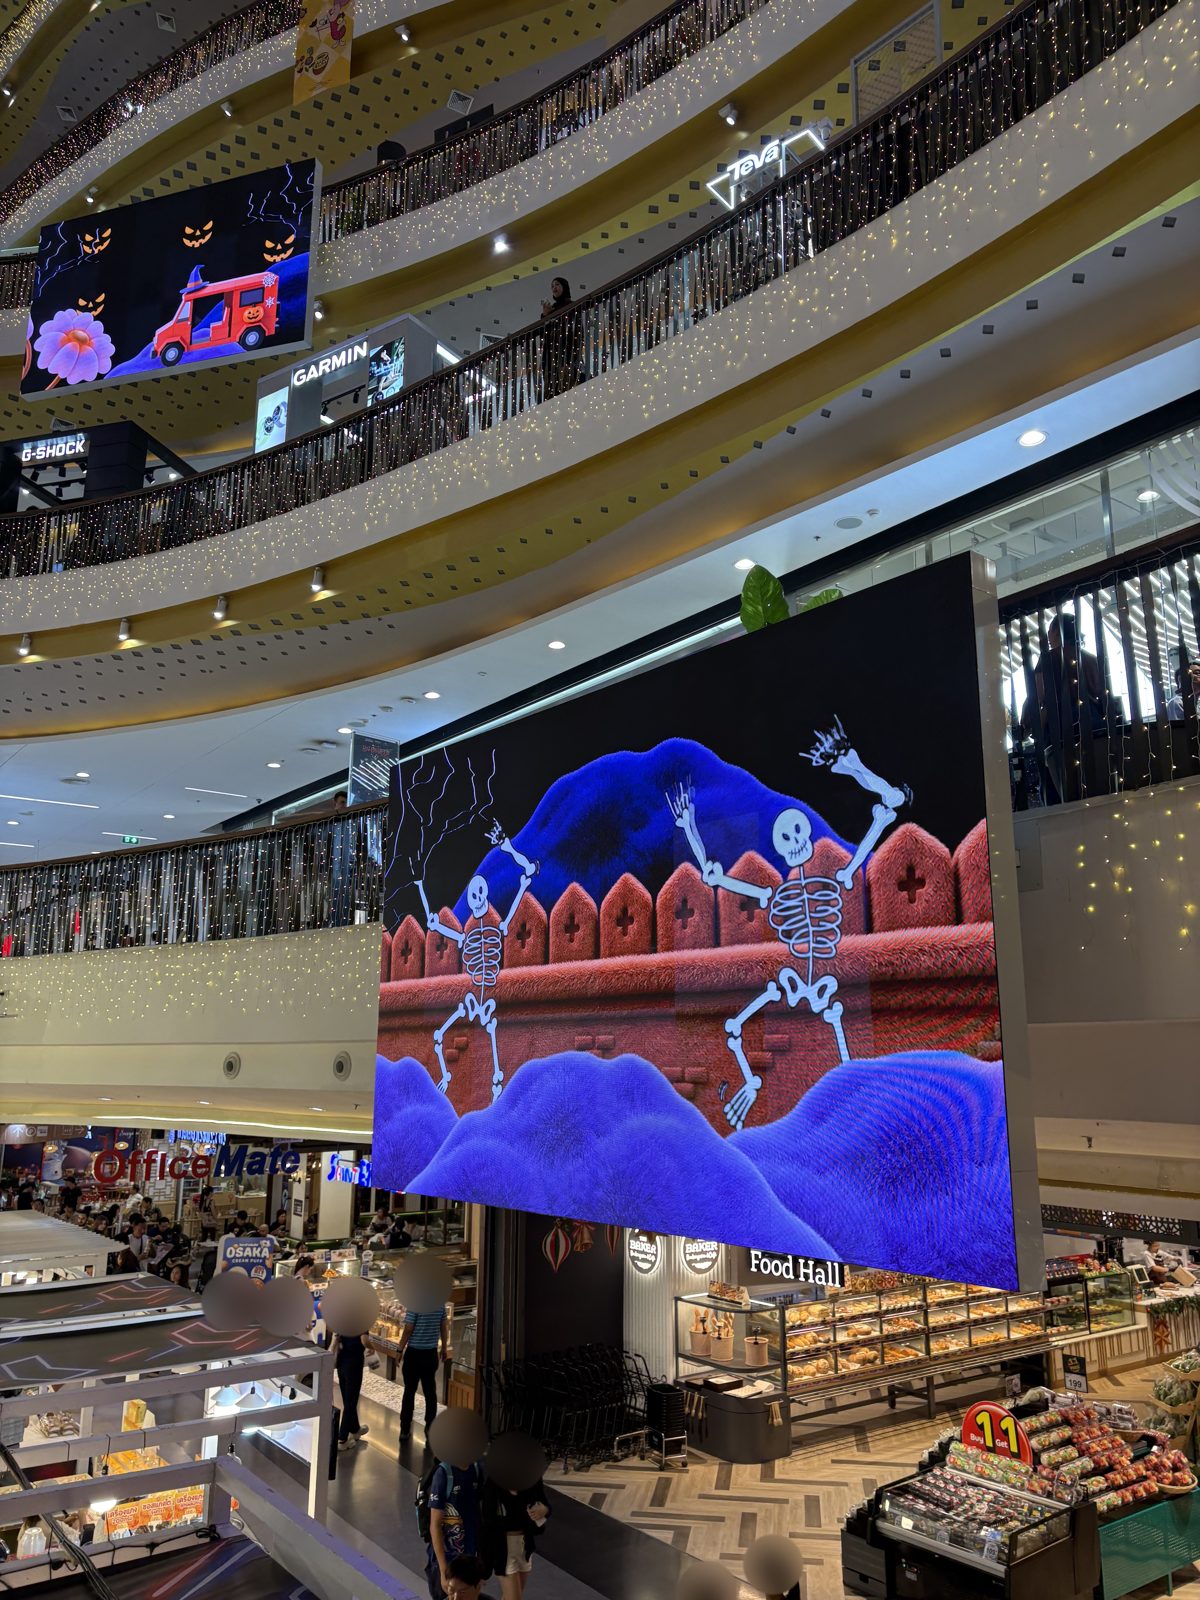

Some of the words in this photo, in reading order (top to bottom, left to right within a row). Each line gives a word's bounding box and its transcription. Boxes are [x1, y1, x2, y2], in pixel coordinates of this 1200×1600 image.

[293, 341, 368, 386] GARMIN
[21, 440, 86, 462] G-SHOCK
[226, 1246, 270, 1258] OSAKA
[629, 1240, 657, 1254] BAKER
[685, 1241, 719, 1254] BAKER
[750, 1250, 795, 1279] Food
[798, 1258, 841, 1288] Hall
[970, 1433, 984, 1445] Buy
[975, 1411, 995, 1450] 1
[1000, 1416, 1020, 1456] 1
[995, 1438, 1009, 1448] Get
